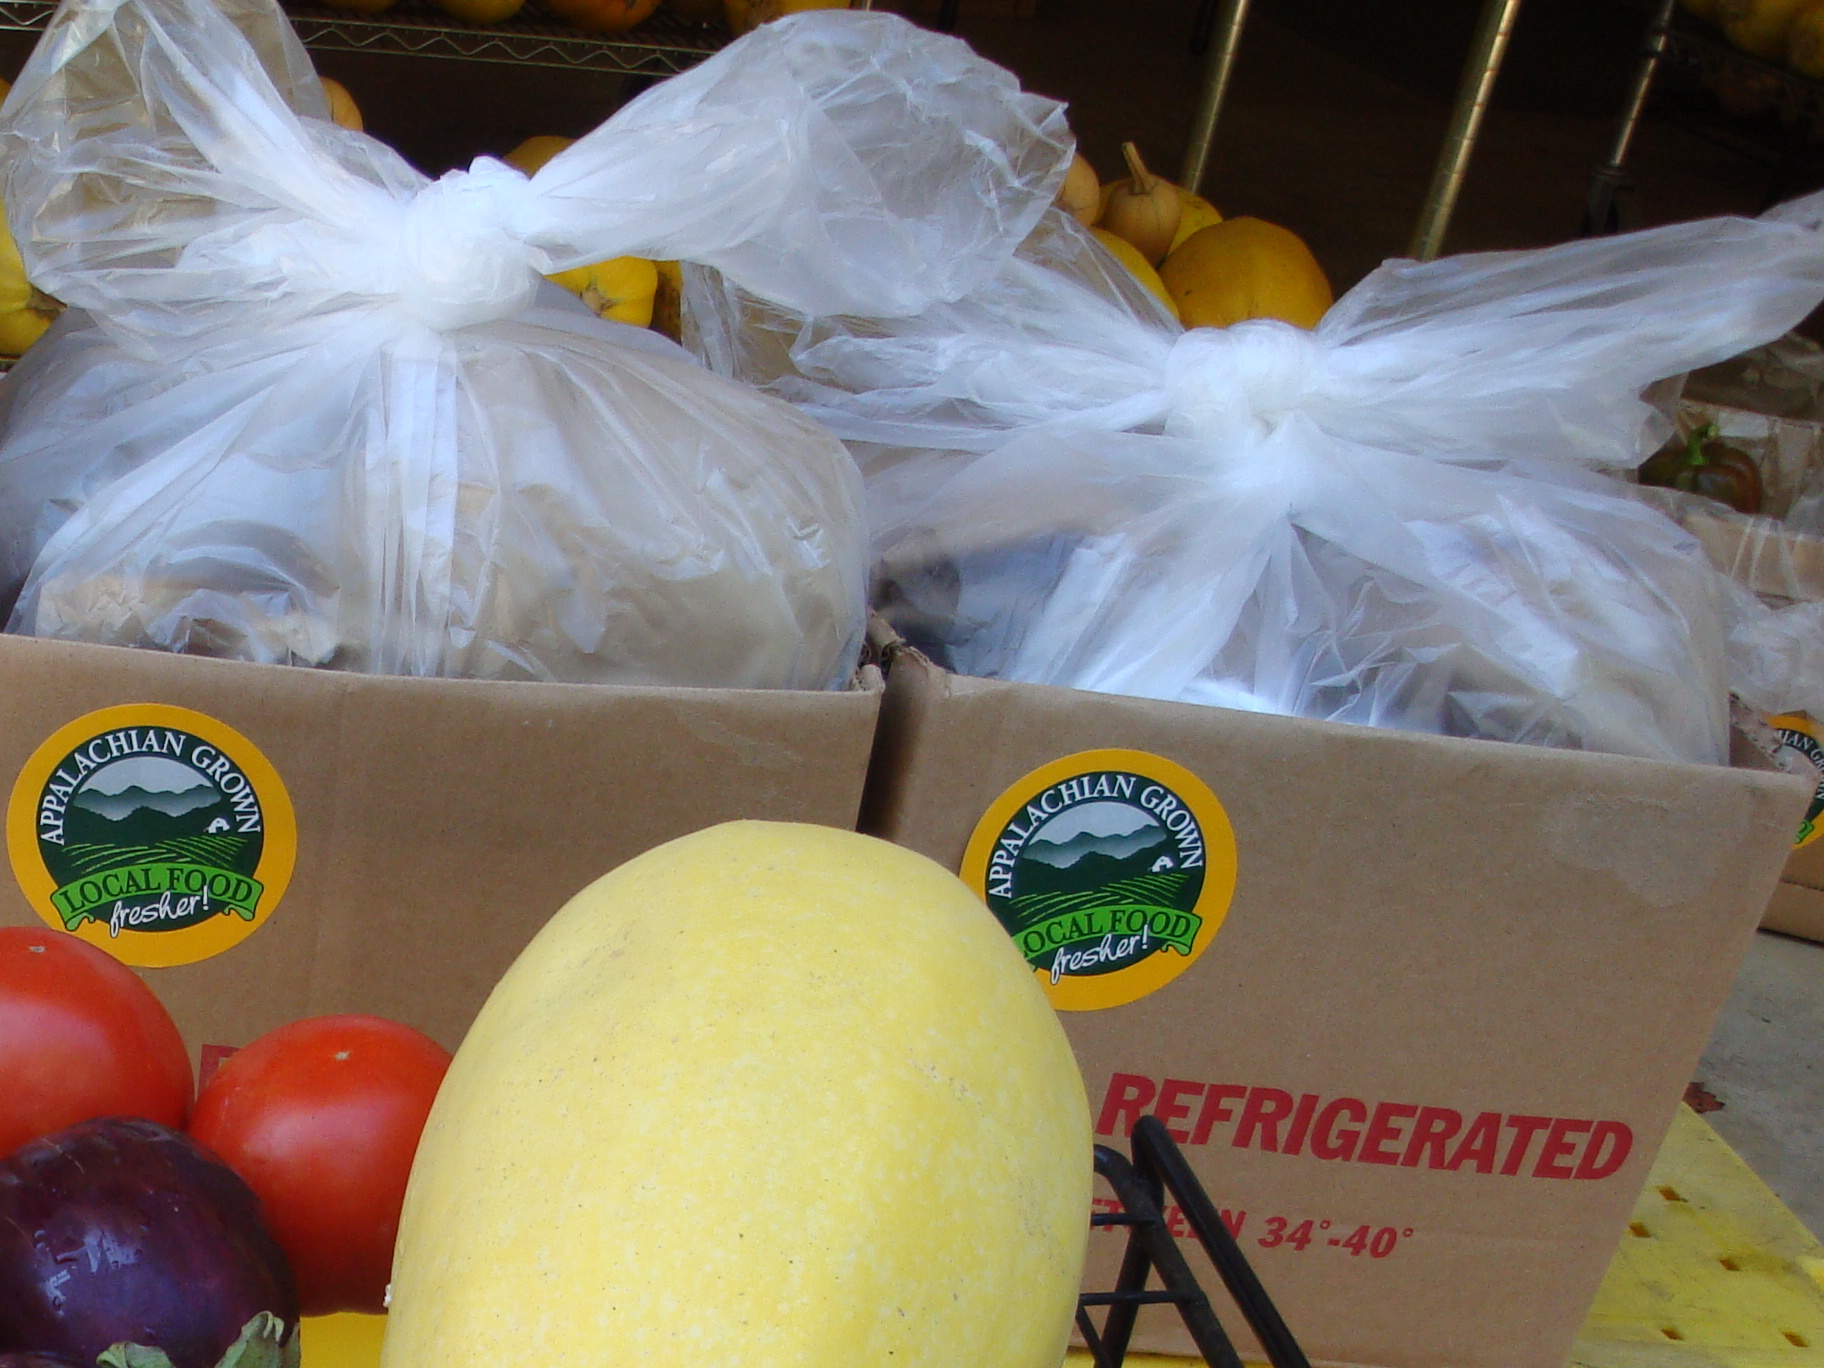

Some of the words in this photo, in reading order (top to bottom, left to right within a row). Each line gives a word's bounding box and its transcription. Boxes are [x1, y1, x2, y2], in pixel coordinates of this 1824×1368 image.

[40, 729, 186, 845] APPALACHIAN
[191, 745, 261, 833] GROWN
[988, 775, 1136, 898] APPALACHIAN
[1140, 785, 1204, 869] GROWN
[59, 868, 161, 913] LOCAL
[167, 867, 254, 904] FOOD
[109, 884, 209, 938] fresher!
[1022, 912, 1103, 958] OCAL
[1110, 910, 1191, 938] FOOD
[1050, 923, 1149, 985] fresher!
[1095, 1073, 1633, 1180] REFRIGERATED
